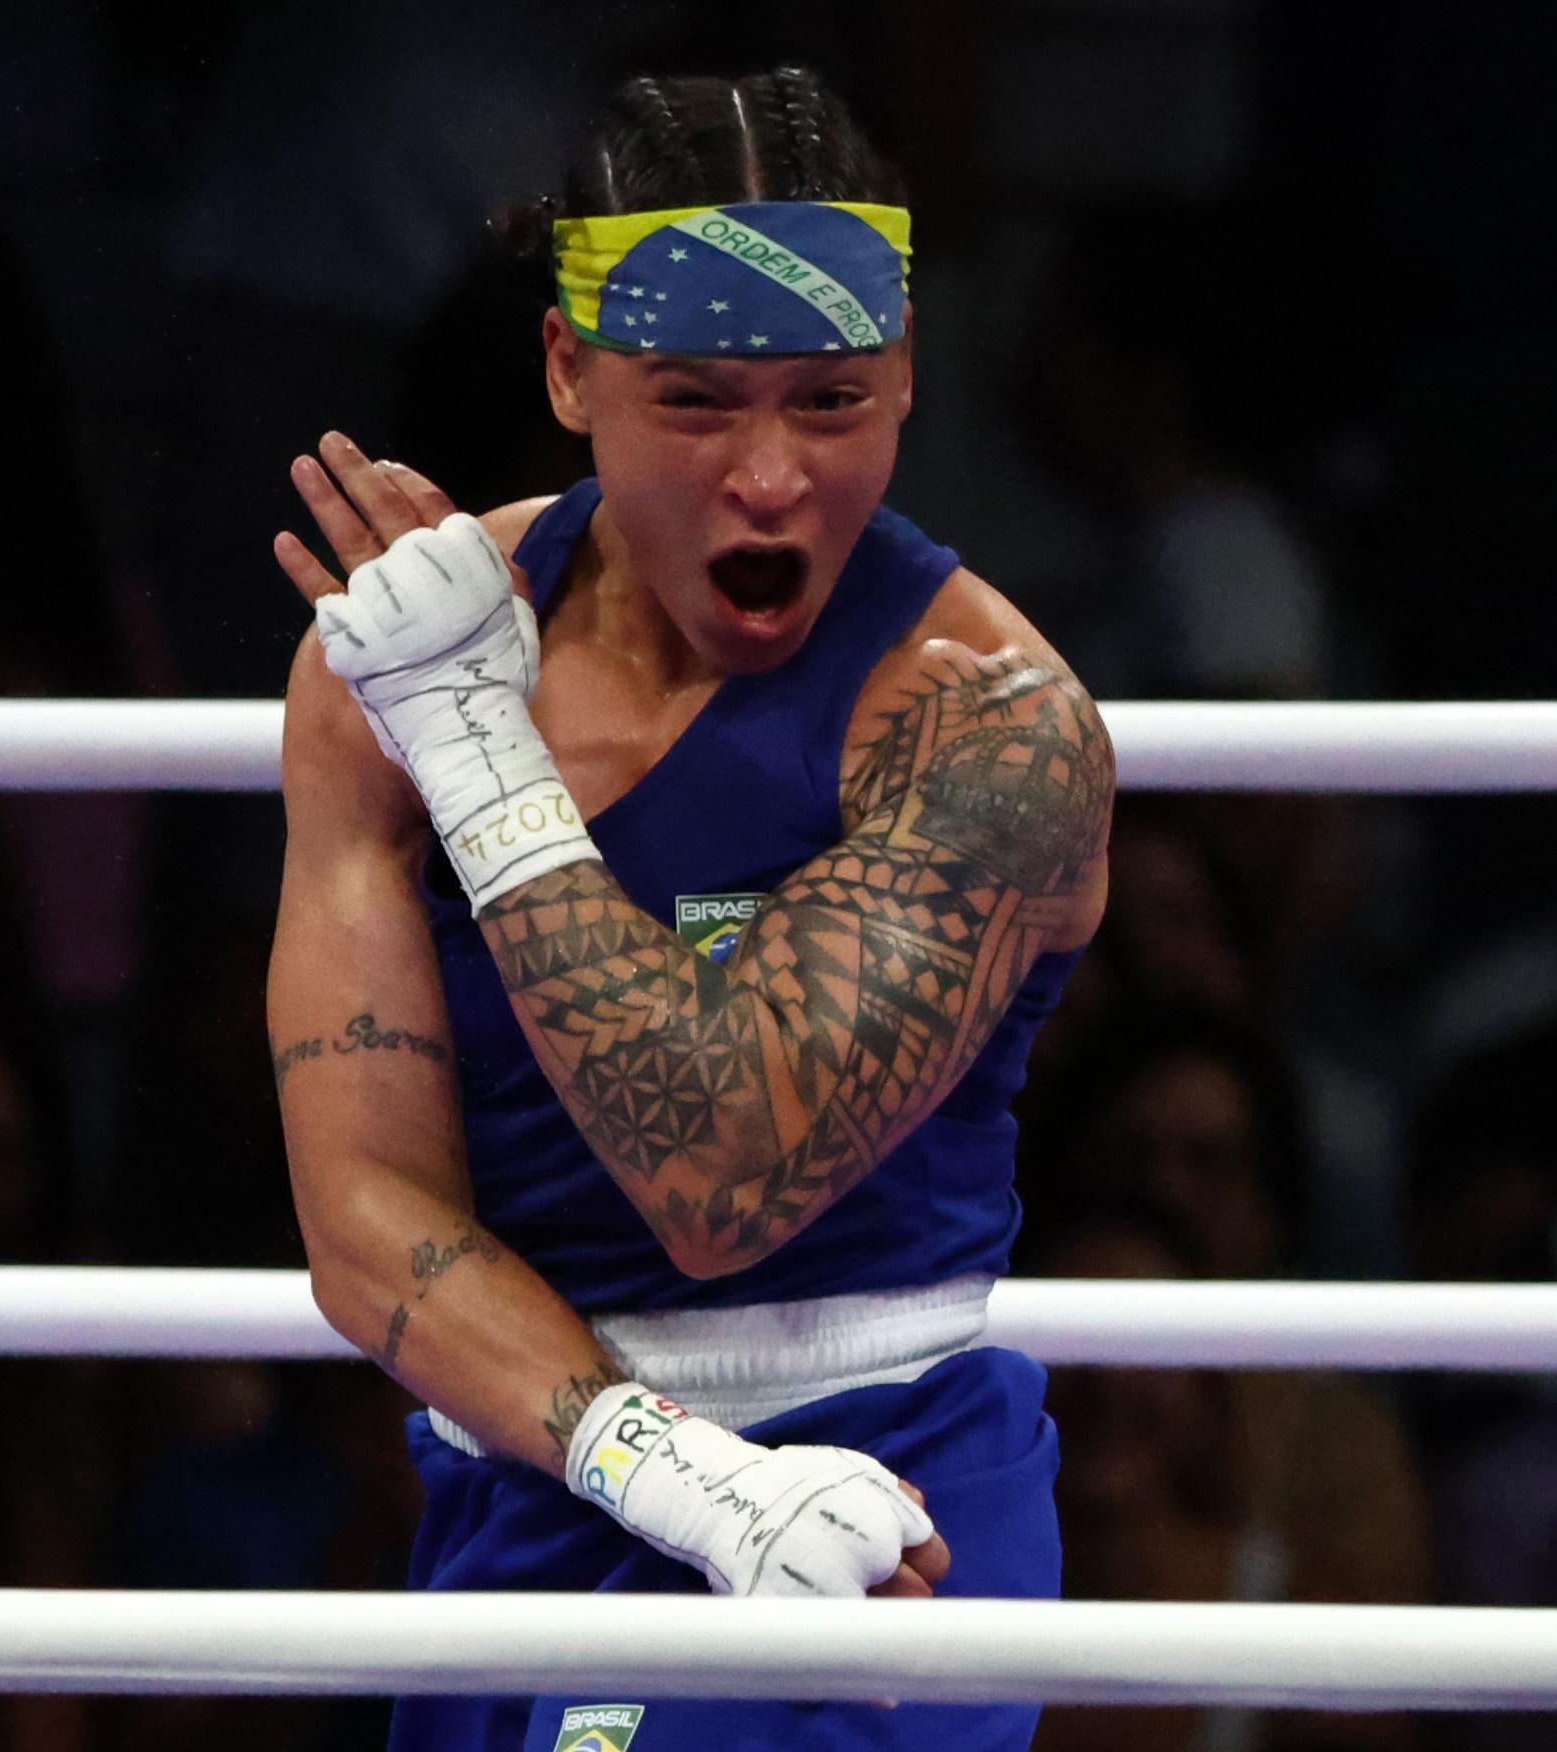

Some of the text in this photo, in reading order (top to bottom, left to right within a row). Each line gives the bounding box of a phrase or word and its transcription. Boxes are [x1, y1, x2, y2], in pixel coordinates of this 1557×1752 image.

[701, 219, 812, 284] ORDEM
[807, 283, 836, 301] E
[458, 792, 576, 861] 2024
[680, 900, 763, 922] BRAS
[564, 1710, 635, 1731] BRASIL
